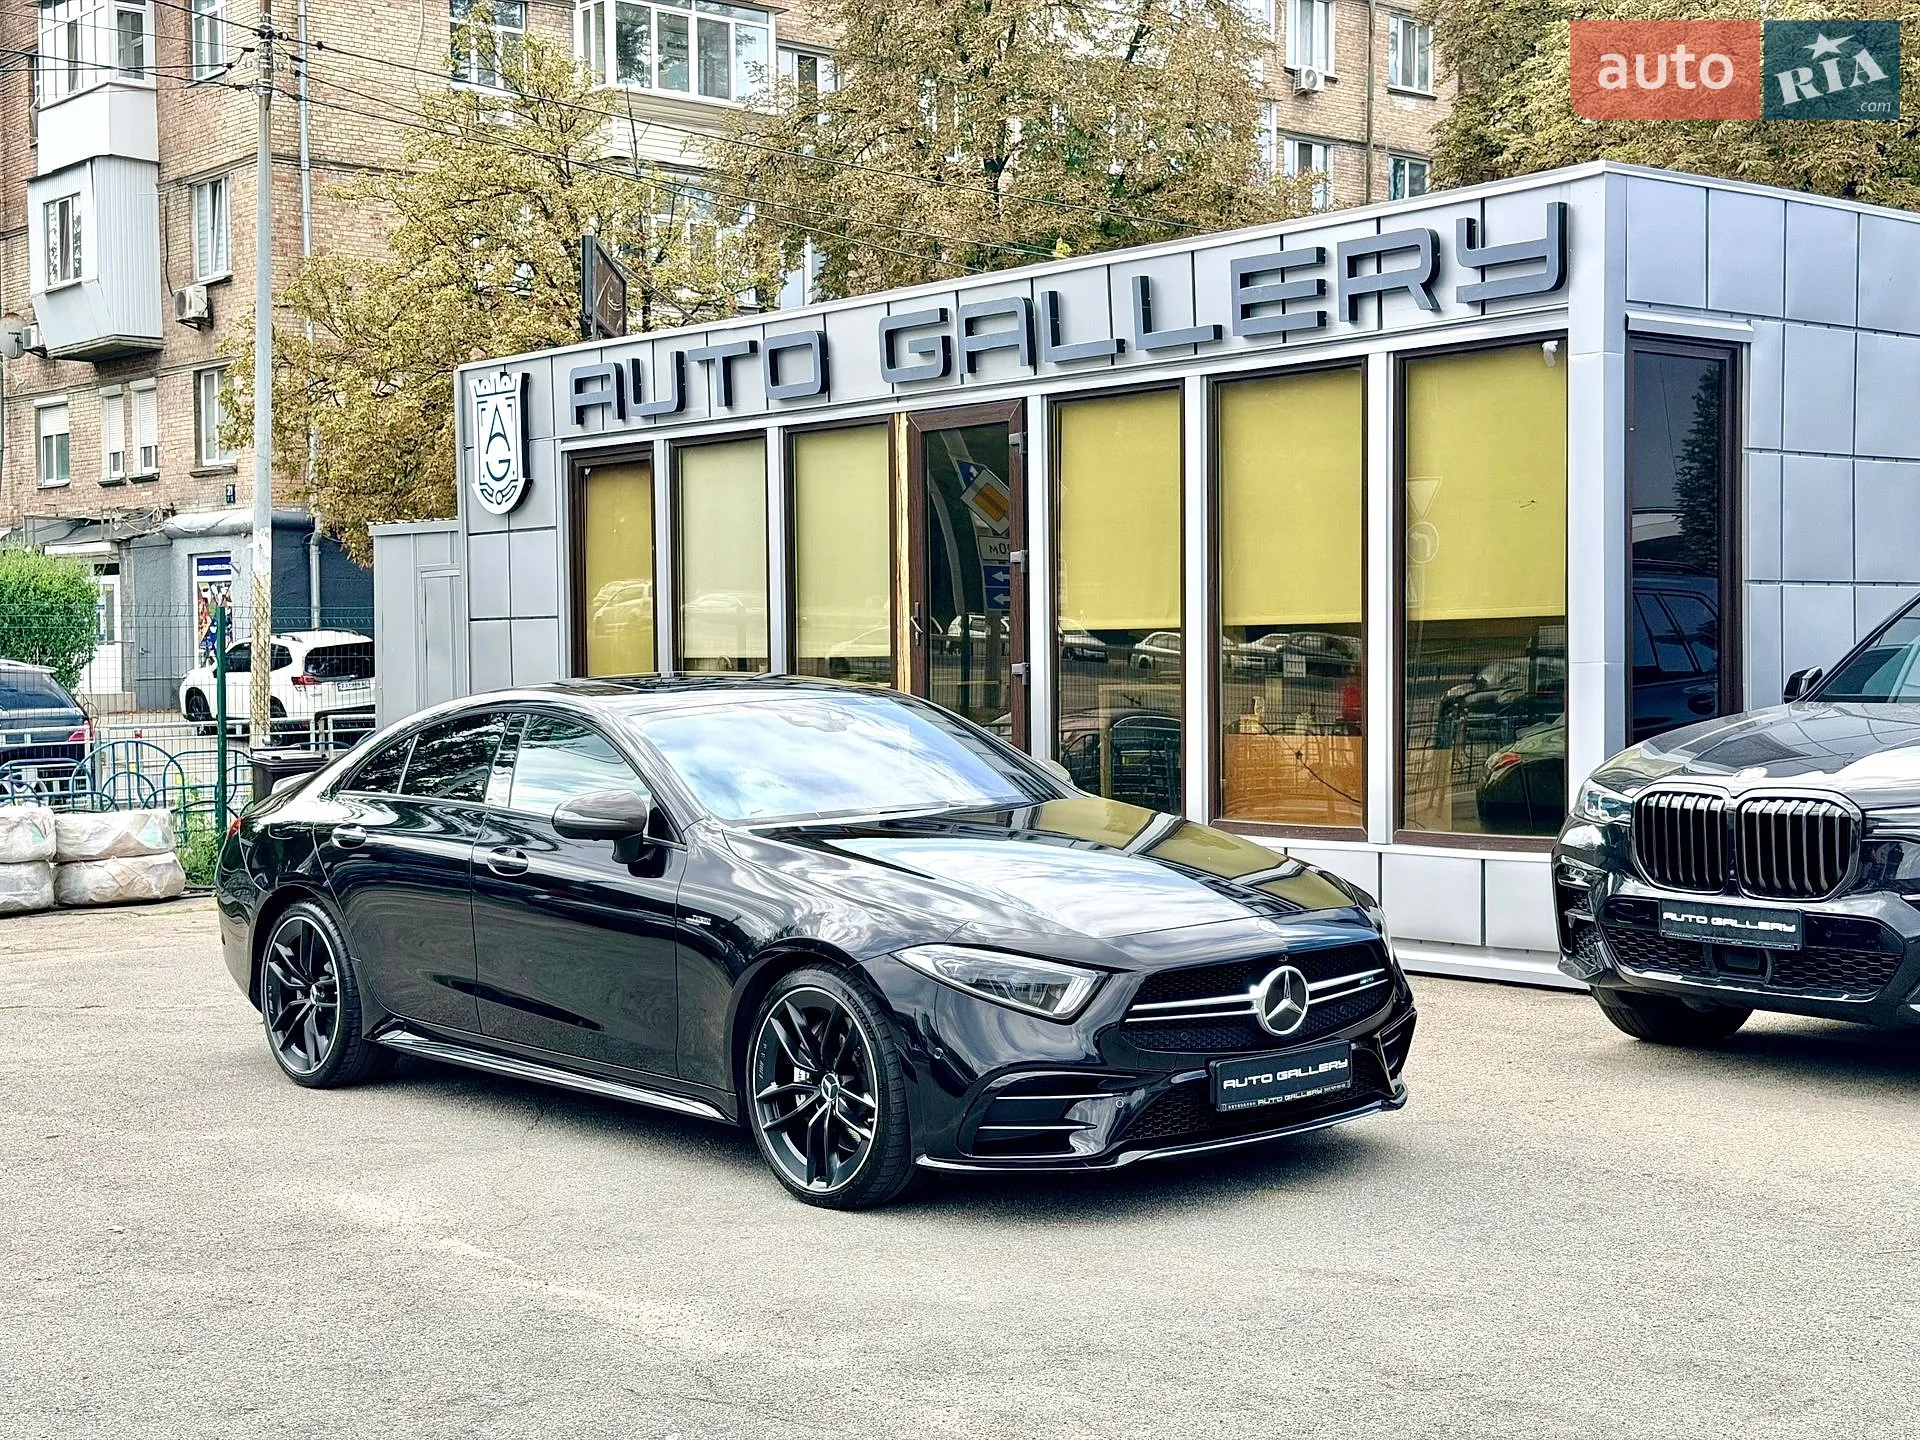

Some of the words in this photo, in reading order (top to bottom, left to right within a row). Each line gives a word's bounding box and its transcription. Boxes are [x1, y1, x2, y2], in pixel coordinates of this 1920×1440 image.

[569, 330, 829, 425] AUTO
[878, 201, 1568, 384] GALLERY
[1662, 911, 1708, 924] AUTO
[1710, 917, 1796, 933] GALLERY
[1223, 1073, 1273, 1090] AUTO
[1276, 1058, 1349, 1081] GALLERY
[1257, 1096, 1283, 1106] AUTO
[1285, 1088, 1322, 1101] GALLERY
